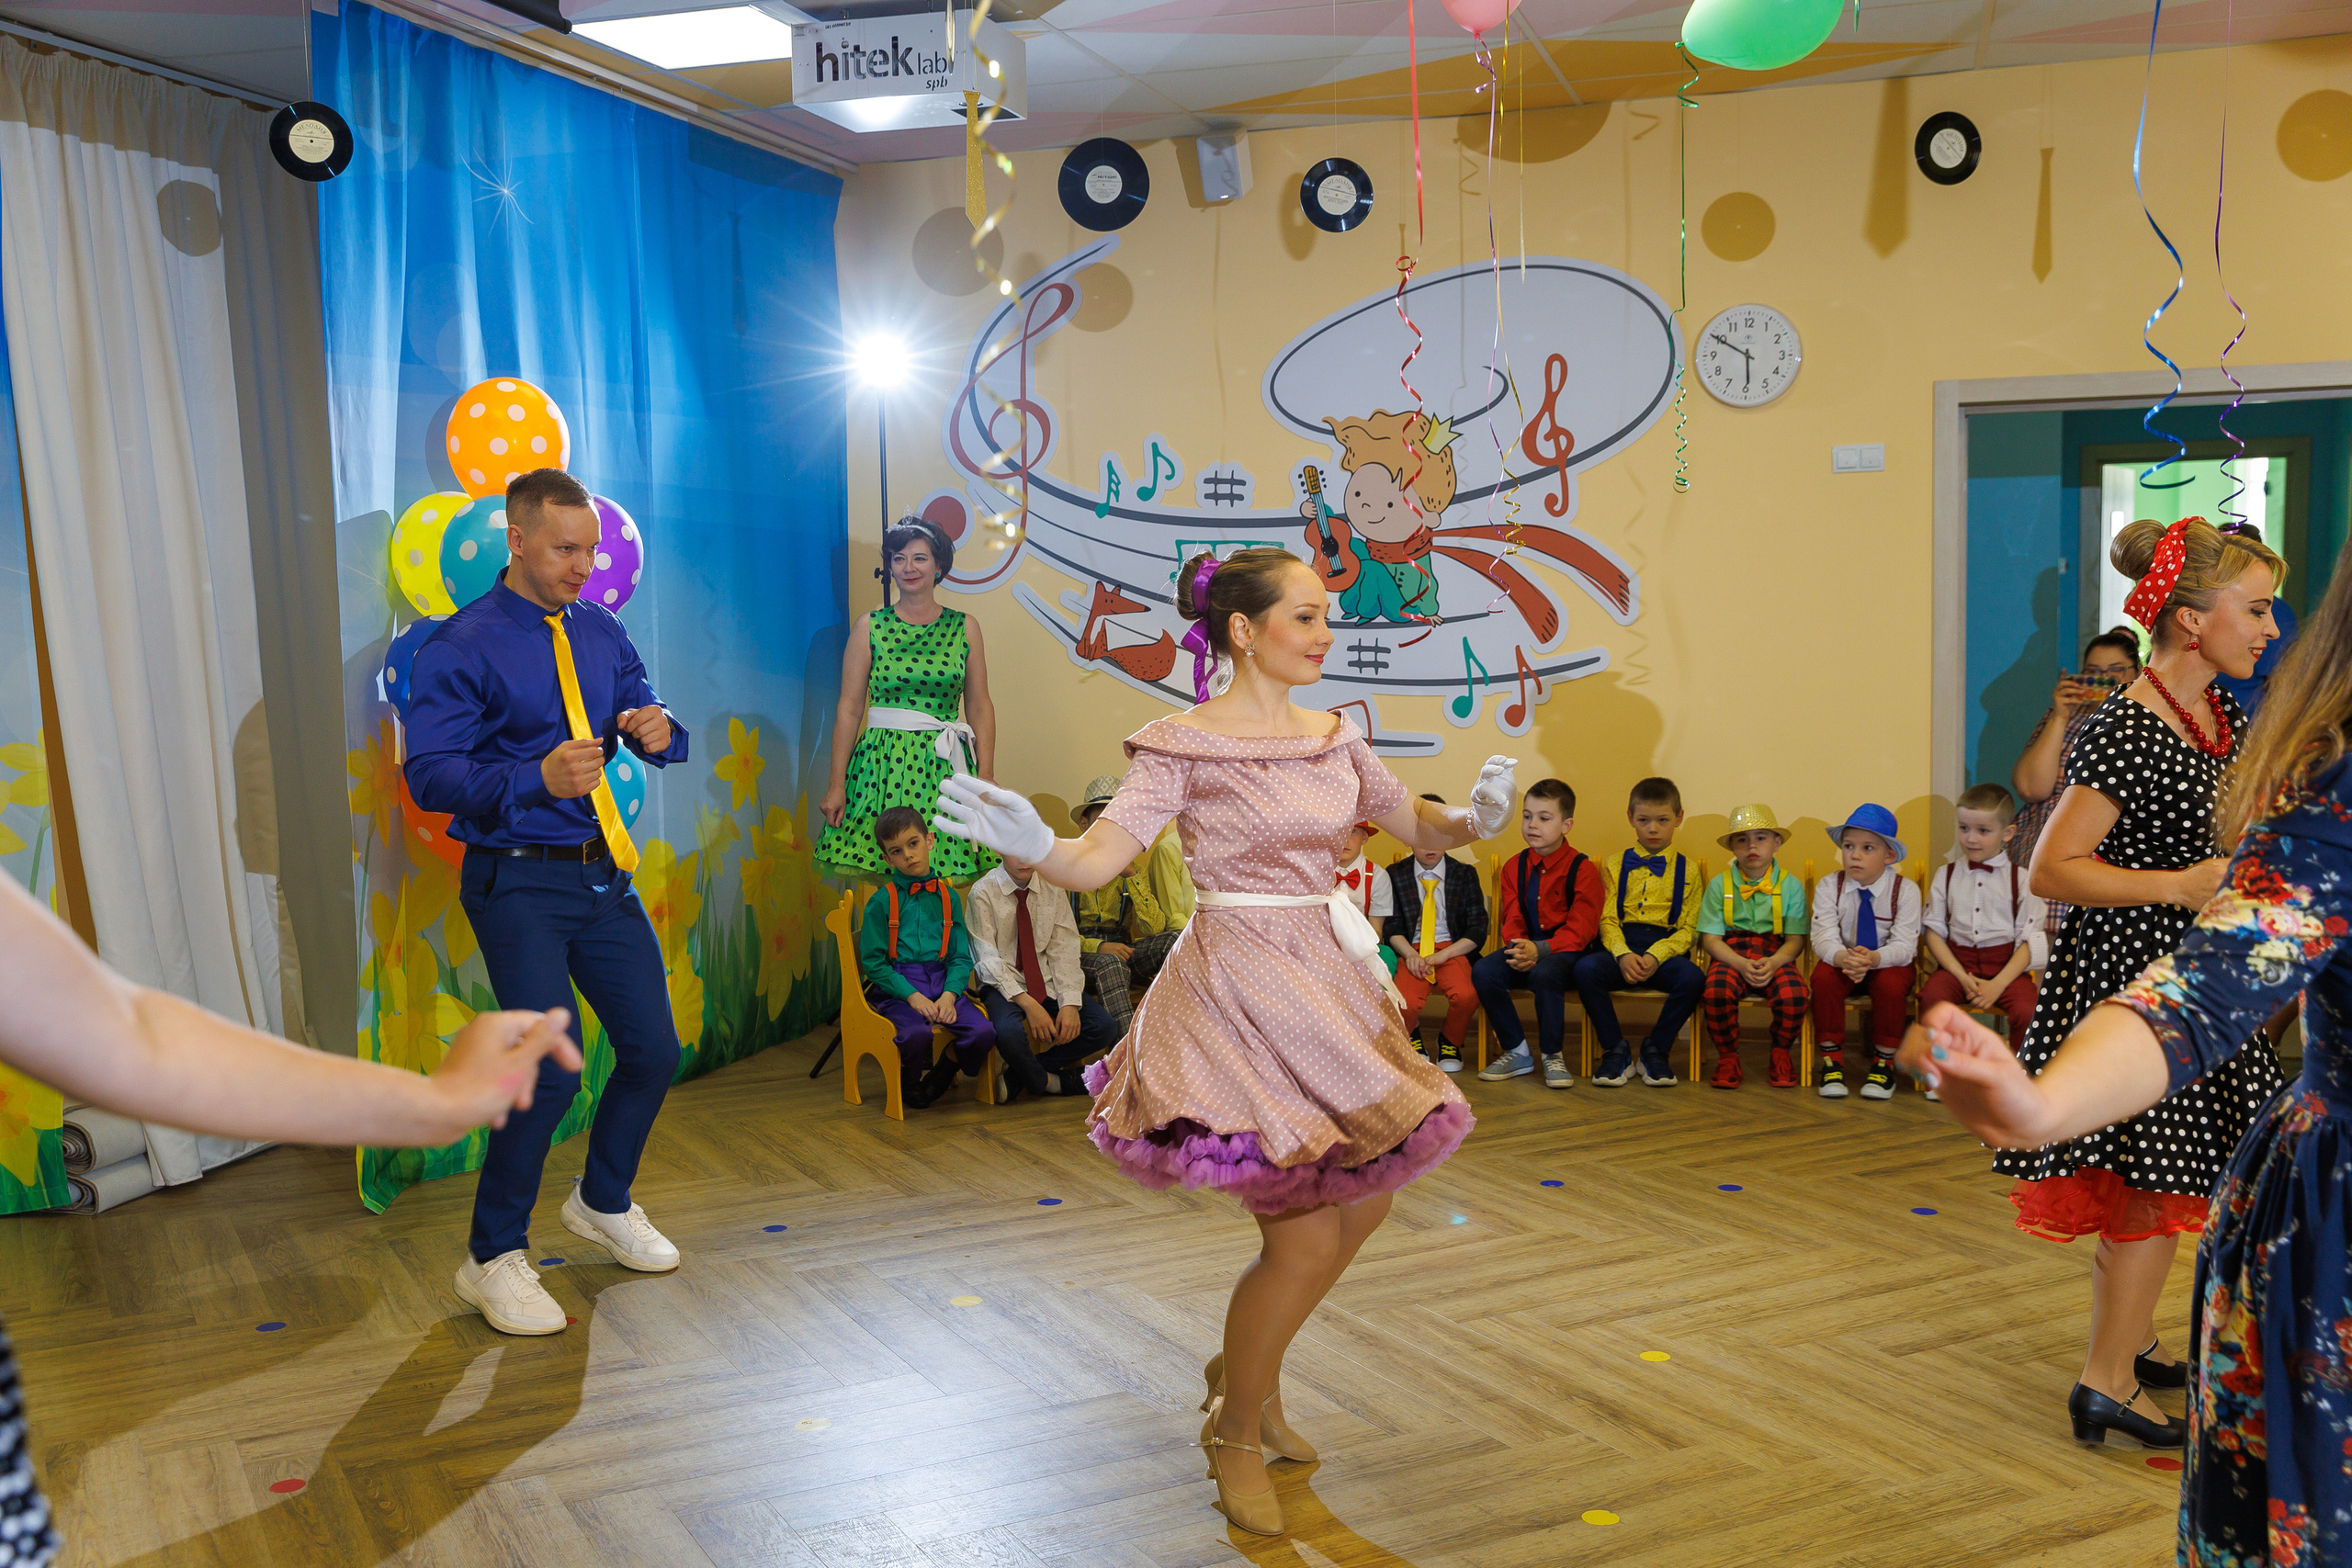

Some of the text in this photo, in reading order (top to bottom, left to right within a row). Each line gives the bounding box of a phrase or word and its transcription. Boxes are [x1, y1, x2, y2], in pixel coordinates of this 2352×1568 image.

[815, 35, 947, 83] hitek lab
[925, 75, 948, 92] spb
[1728, 321, 1737, 333] 11
[1745, 317, 1755, 328] 12
[1764, 321, 1769, 332] 1
[1773, 333, 1781, 344] 2
[1710, 351, 1717, 361] 9
[1779, 350, 1786, 360] 3
[1714, 366, 1722, 376] 8
[1772, 365, 1780, 375] 4
[1725, 378, 1733, 389] 7
[1742, 383, 1749, 393] 6
[1761, 378, 1769, 389] 5
